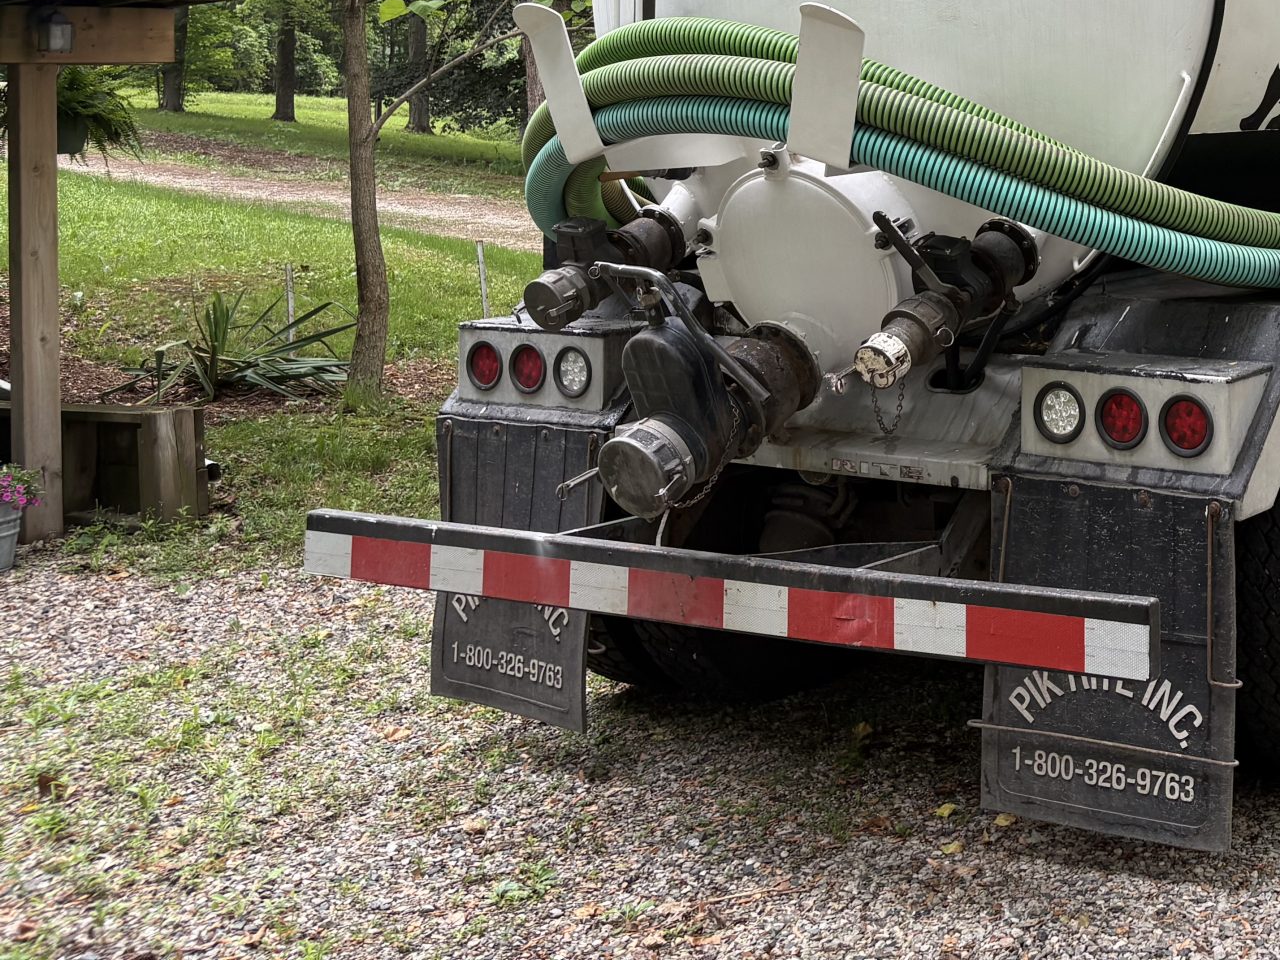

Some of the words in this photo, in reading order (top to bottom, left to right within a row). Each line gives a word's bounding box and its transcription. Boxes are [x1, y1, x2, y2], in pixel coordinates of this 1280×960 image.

[452, 640, 563, 689] 1-800-326-9763
[1141, 678, 1203, 749] INC.
[1011, 745, 1195, 802] 1-800-326-9763
